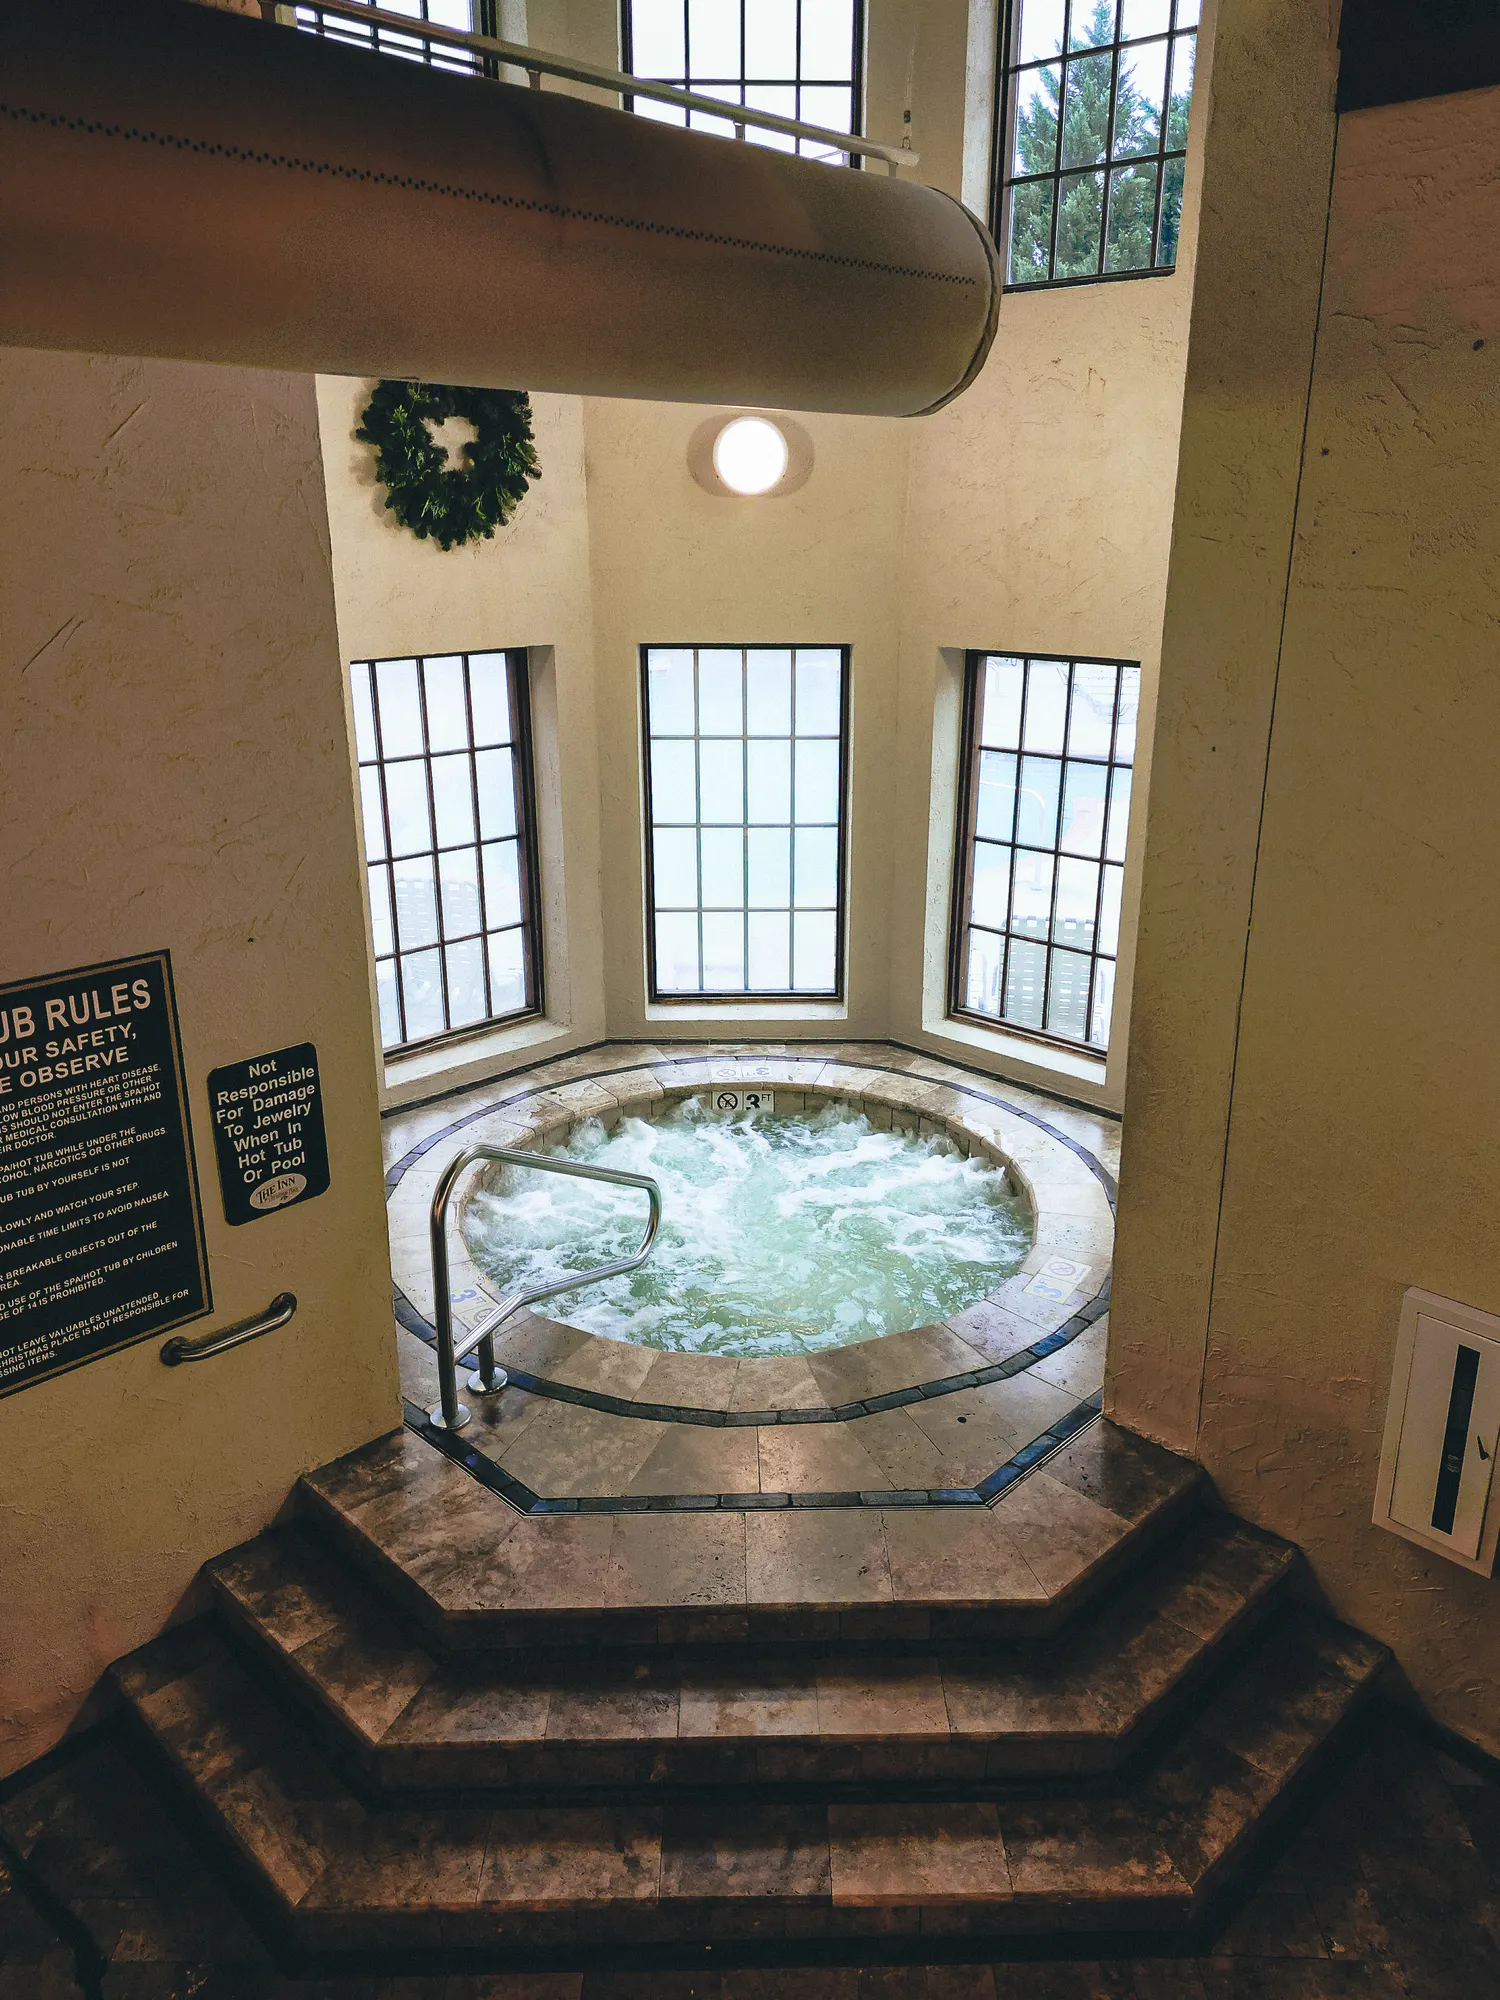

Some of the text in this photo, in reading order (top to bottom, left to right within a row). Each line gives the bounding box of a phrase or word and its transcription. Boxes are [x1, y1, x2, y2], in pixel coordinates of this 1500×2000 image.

[45, 979, 151, 1031] RULES
[0, 1022, 137, 1069] UR SAFETY,
[19, 1046, 129, 1088] OBSERVE
[217, 1066, 315, 1106] Responsible
[248, 1059, 277, 1078] Not
[0, 1103, 15, 1114] ND
[17, 1090, 63, 1108] PERSONS
[64, 1083, 88, 1096] WITH
[89, 1074, 120, 1089] HEART
[10, 1113, 50, 1131] SHOULD
[51, 1107, 71, 1119] NOT
[73, 1098, 103, 1113] ENTER
[105, 1094, 122, 1104] THE
[124, 1082, 161, 1100] SPA/HOT
[21, 1102, 55, 1118] BLOOD
[56, 1086, 106, 1108] PRESSURE
[107, 1082, 120, 1093] OR
[122, 1075, 152, 1090] OTHER
[216, 1084, 315, 1124] For Damage
[746, 1094, 771, 1110] 3 FT
[5, 1124, 48, 1142] MEDICAL
[50, 1104, 118, 1129] CONSULTATION
[119, 1098, 142, 1110] WITH
[143, 1091, 161, 1103] AND
[223, 1102, 312, 1138] To Jewelry
[14, 1131, 57, 1149] DOCTOR.
[33, 1151, 87, 1174] NARCOTICS
[89, 1146, 102, 1156] OR
[104, 1137, 135, 1152] OTHER
[34, 1151, 54, 1163] TUB
[55, 1142, 85, 1157] WHILE
[86, 1133, 117, 1148] UNDER
[119, 1126, 137, 1138] THE
[233, 1122, 302, 1153] When In
[238, 1137, 302, 1169] Hot Tub
[15, 1187, 35, 1198] TUB
[36, 1182, 49, 1192] BY
[51, 1166, 100, 1187] YOURSELF
[101, 1162, 110, 1172] IS
[112, 1156, 130, 1168] NOT
[243, 1151, 306, 1184] Or Pool
[34, 1210, 54, 1222] AND
[55, 1198, 87, 1215] WATCH
[89, 1190, 114, 1203] YOUR
[116, 1182, 139, 1195] STEP.
[256, 1184, 277, 1204] THE
[277, 1176, 296, 1190] INN
[37, 1227, 59, 1240] TIME
[61, 1216, 91, 1232] LIMITS
[92, 1212, 105, 1222] TO
[106, 1202, 133, 1217] AVOID
[134, 1190, 170, 1208] NAUSEA
[6, 1254, 63, 1280] BREAKABLE
[64, 1239, 106, 1259] OBJECTS
[107, 1231, 126, 1244] OUT
[127, 1227, 139, 1237] OF
[141, 1221, 158, 1233] THE
[7, 1295, 27, 1308] USE
[28, 1289, 41, 1299] OF
[43, 1283, 62, 1295] THE
[63, 1268, 101, 1288] SPA/HOT
[103, 1261, 121, 1273] TUB
[122, 1256, 135, 1266] BY
[136, 1241, 178, 1261] CHILDREN
[12, 1305, 25, 1316] OF
[27, 1301, 37, 1310] 14
[39, 1297, 48, 1306] IS
[50, 1277, 107, 1302] PROHIBITED.
[0, 1288, 189, 1368] HRISTMAS PLACE IS NOT RESPONSIBLE FOR
[17, 1334, 47, 1352] LEAVE
[49, 1314, 101, 1339] VALUABLES
[102, 1291, 159, 1319] UNATTENDED
[27, 1350, 58, 1367] ITEMS.
